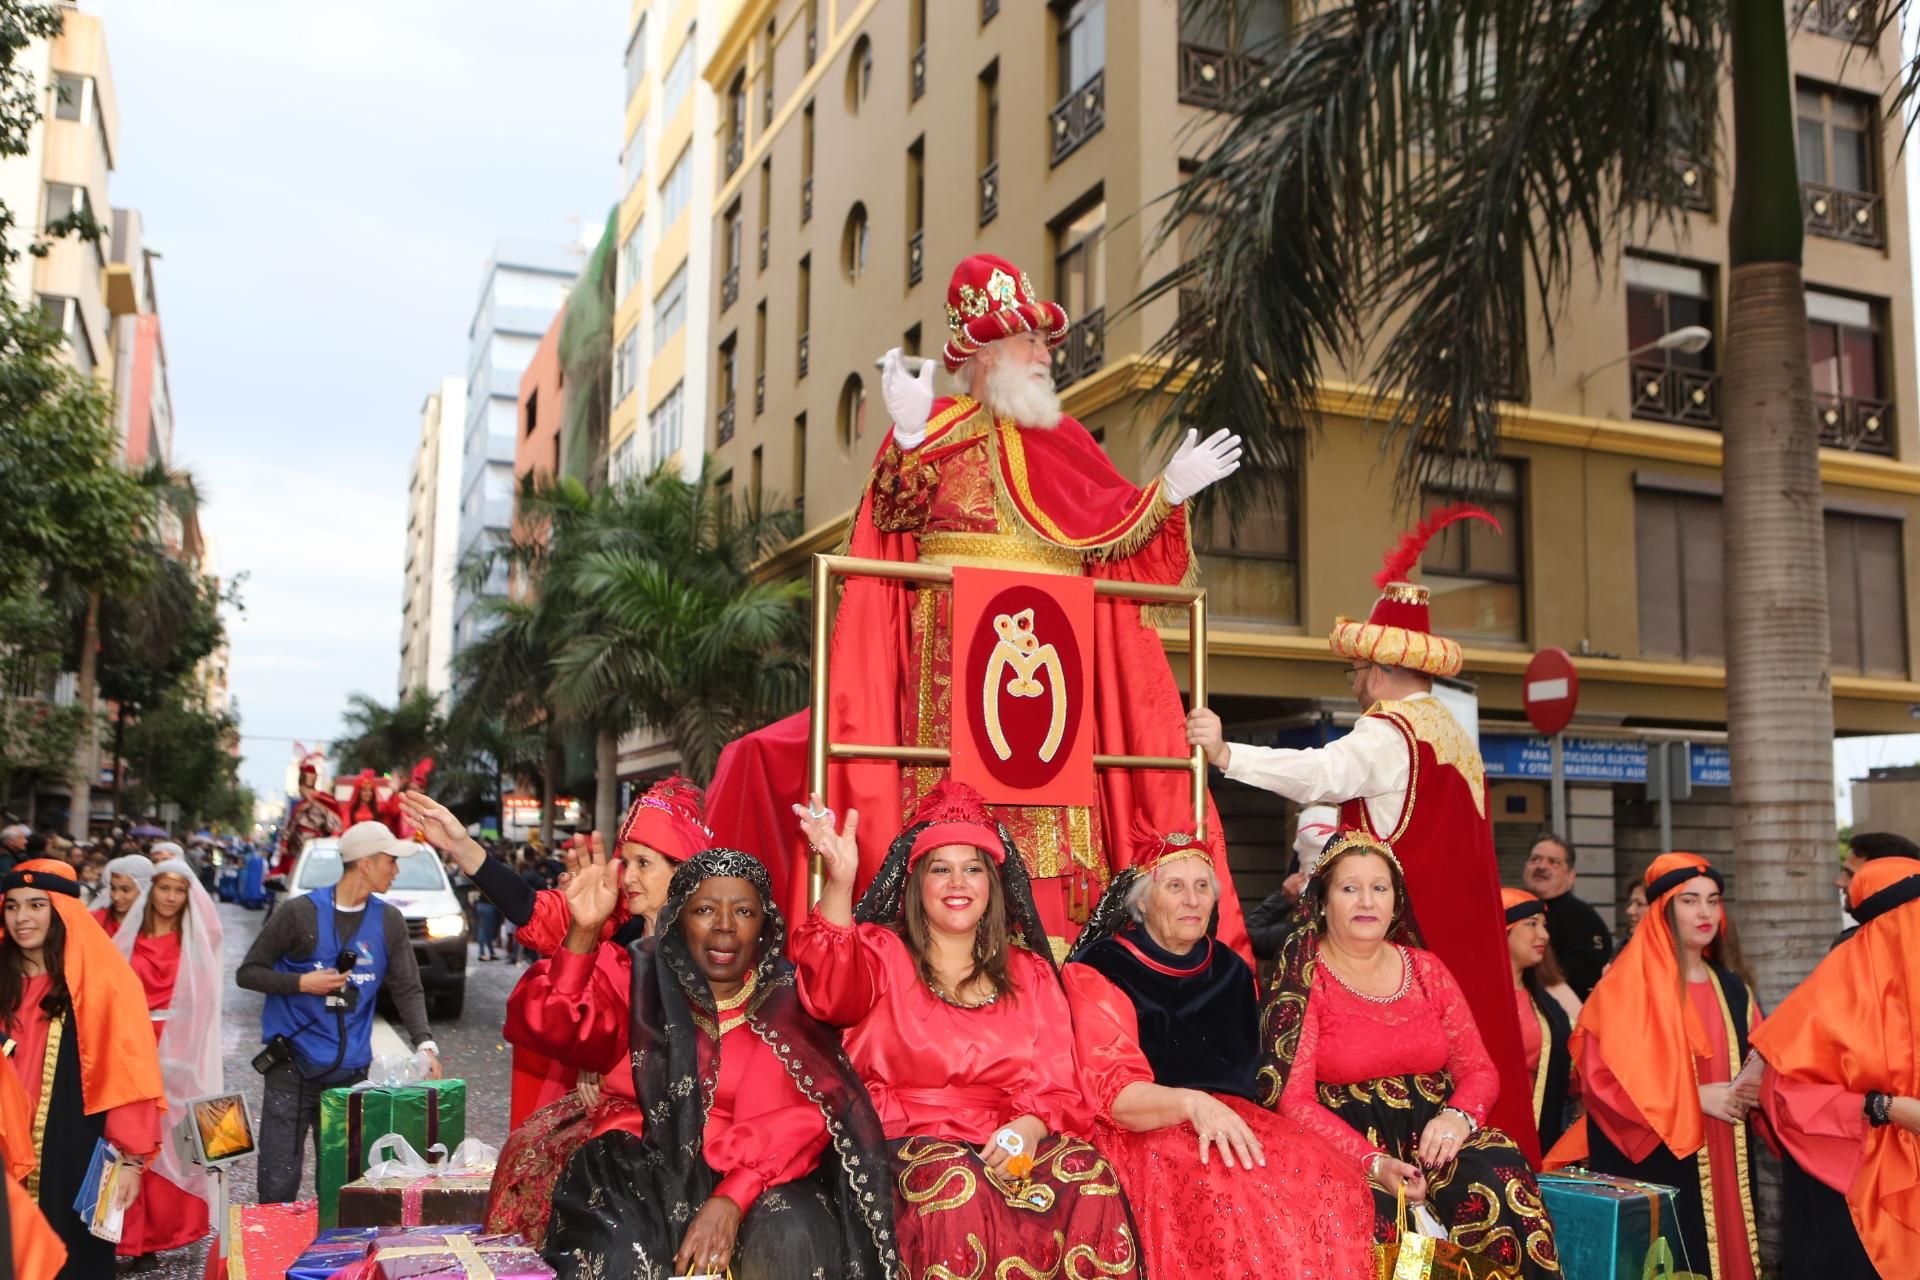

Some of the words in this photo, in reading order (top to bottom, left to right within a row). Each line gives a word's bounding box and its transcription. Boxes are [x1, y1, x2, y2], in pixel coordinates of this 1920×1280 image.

[1522, 750, 1549, 760] PARA
[1518, 762, 1526, 772] Y
[1565, 764, 1624, 777] MATERIALES
